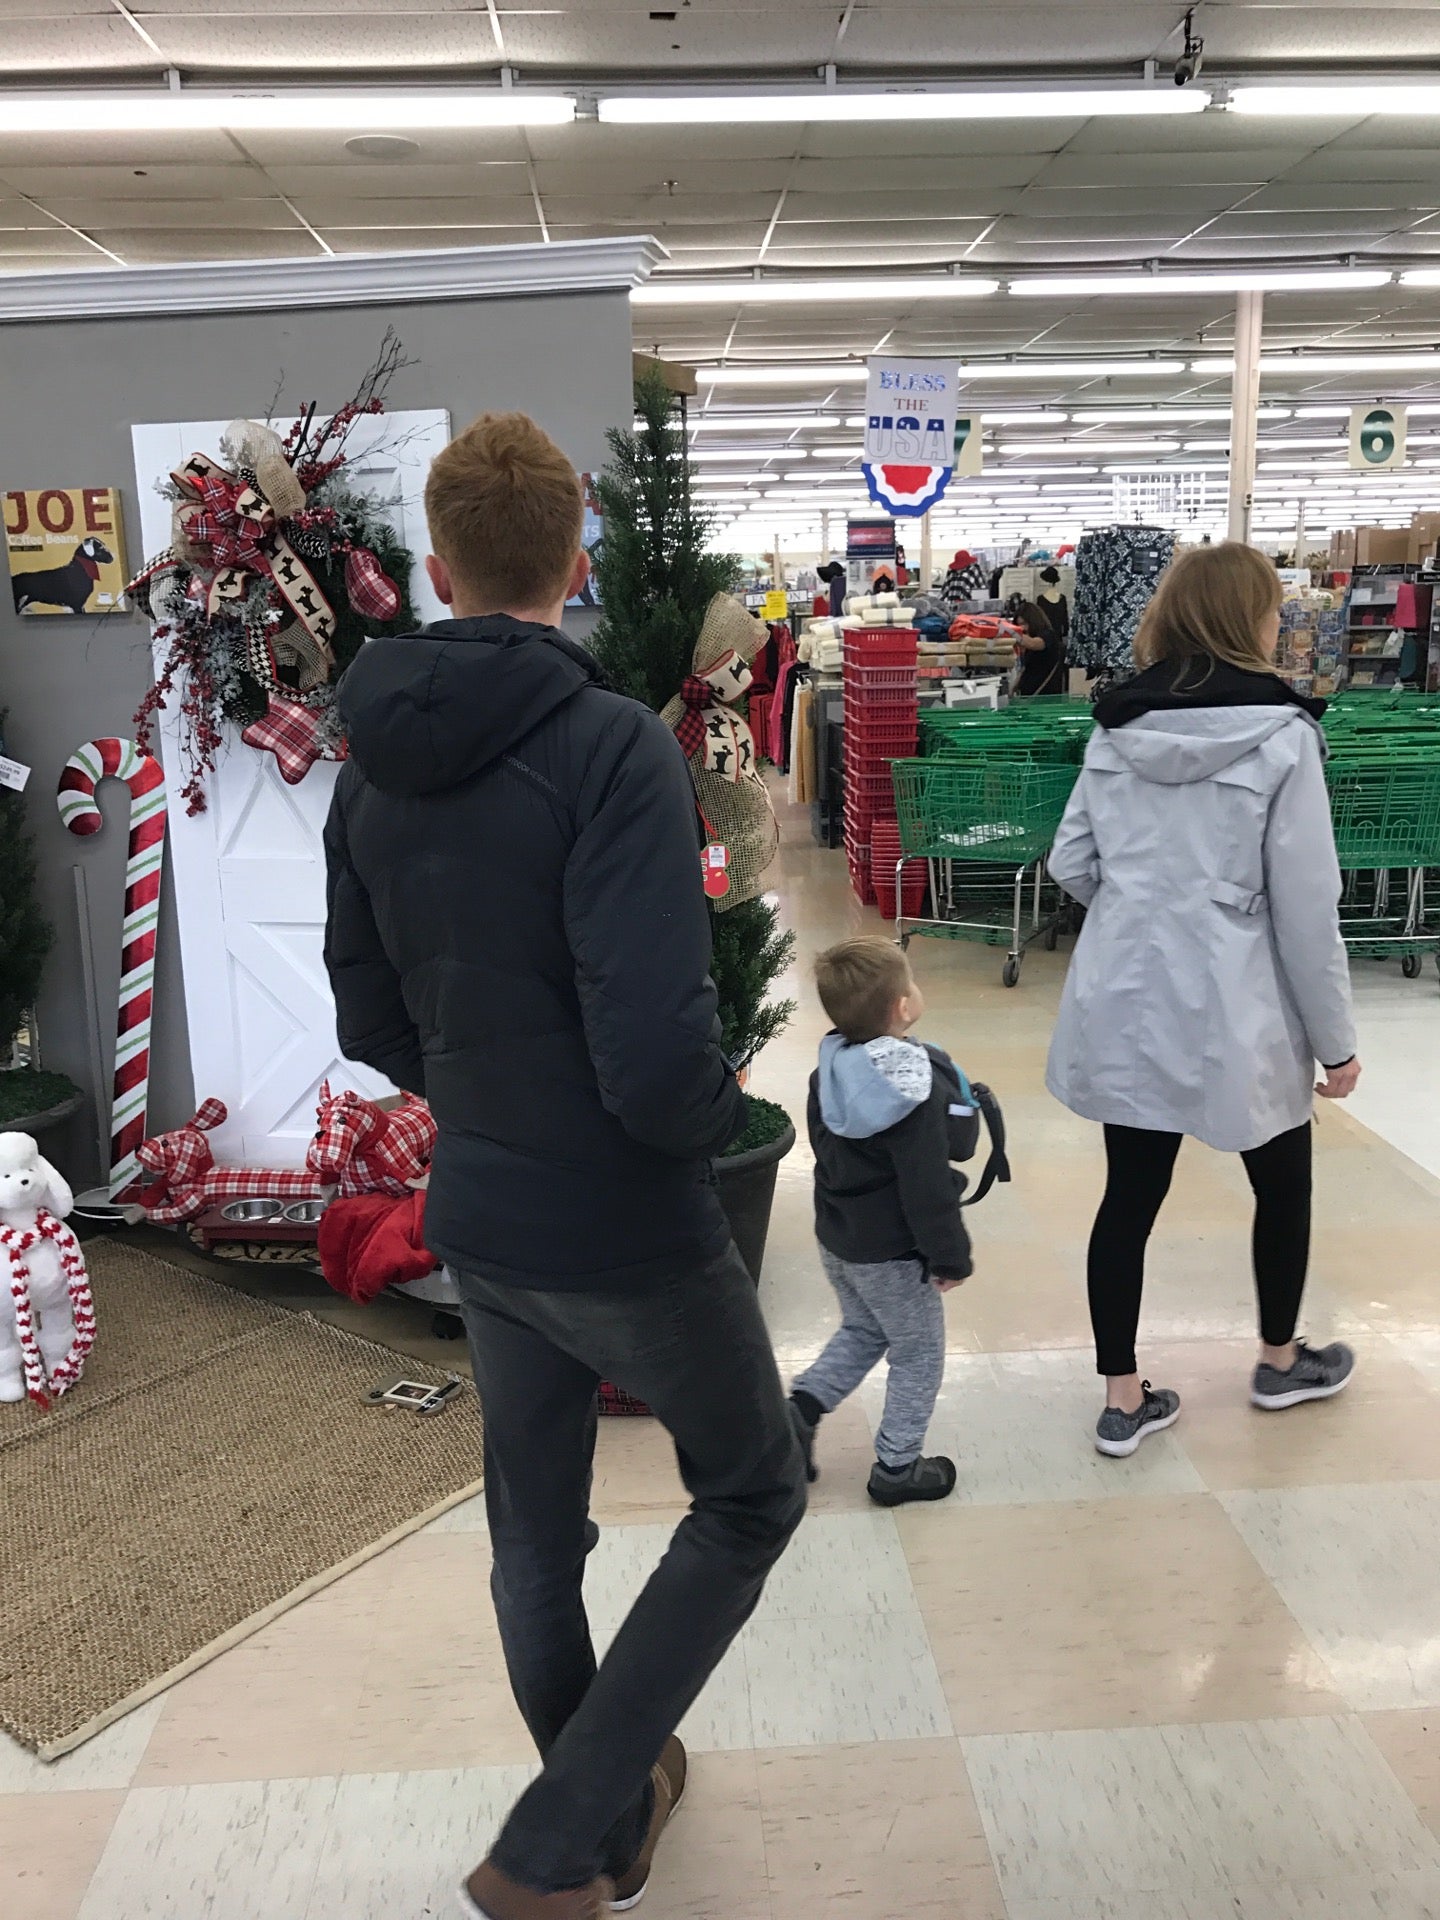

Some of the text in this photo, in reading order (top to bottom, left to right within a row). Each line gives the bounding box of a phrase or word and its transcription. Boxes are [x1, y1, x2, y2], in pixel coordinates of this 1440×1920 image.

[878, 371, 947, 393] BLESS
[894, 397, 929, 412] THE
[867, 416, 947, 461] USA
[1360, 409, 1395, 464] 6
[7, 489, 112, 534] JOE
[8, 534, 79, 546] Coffee Beans
